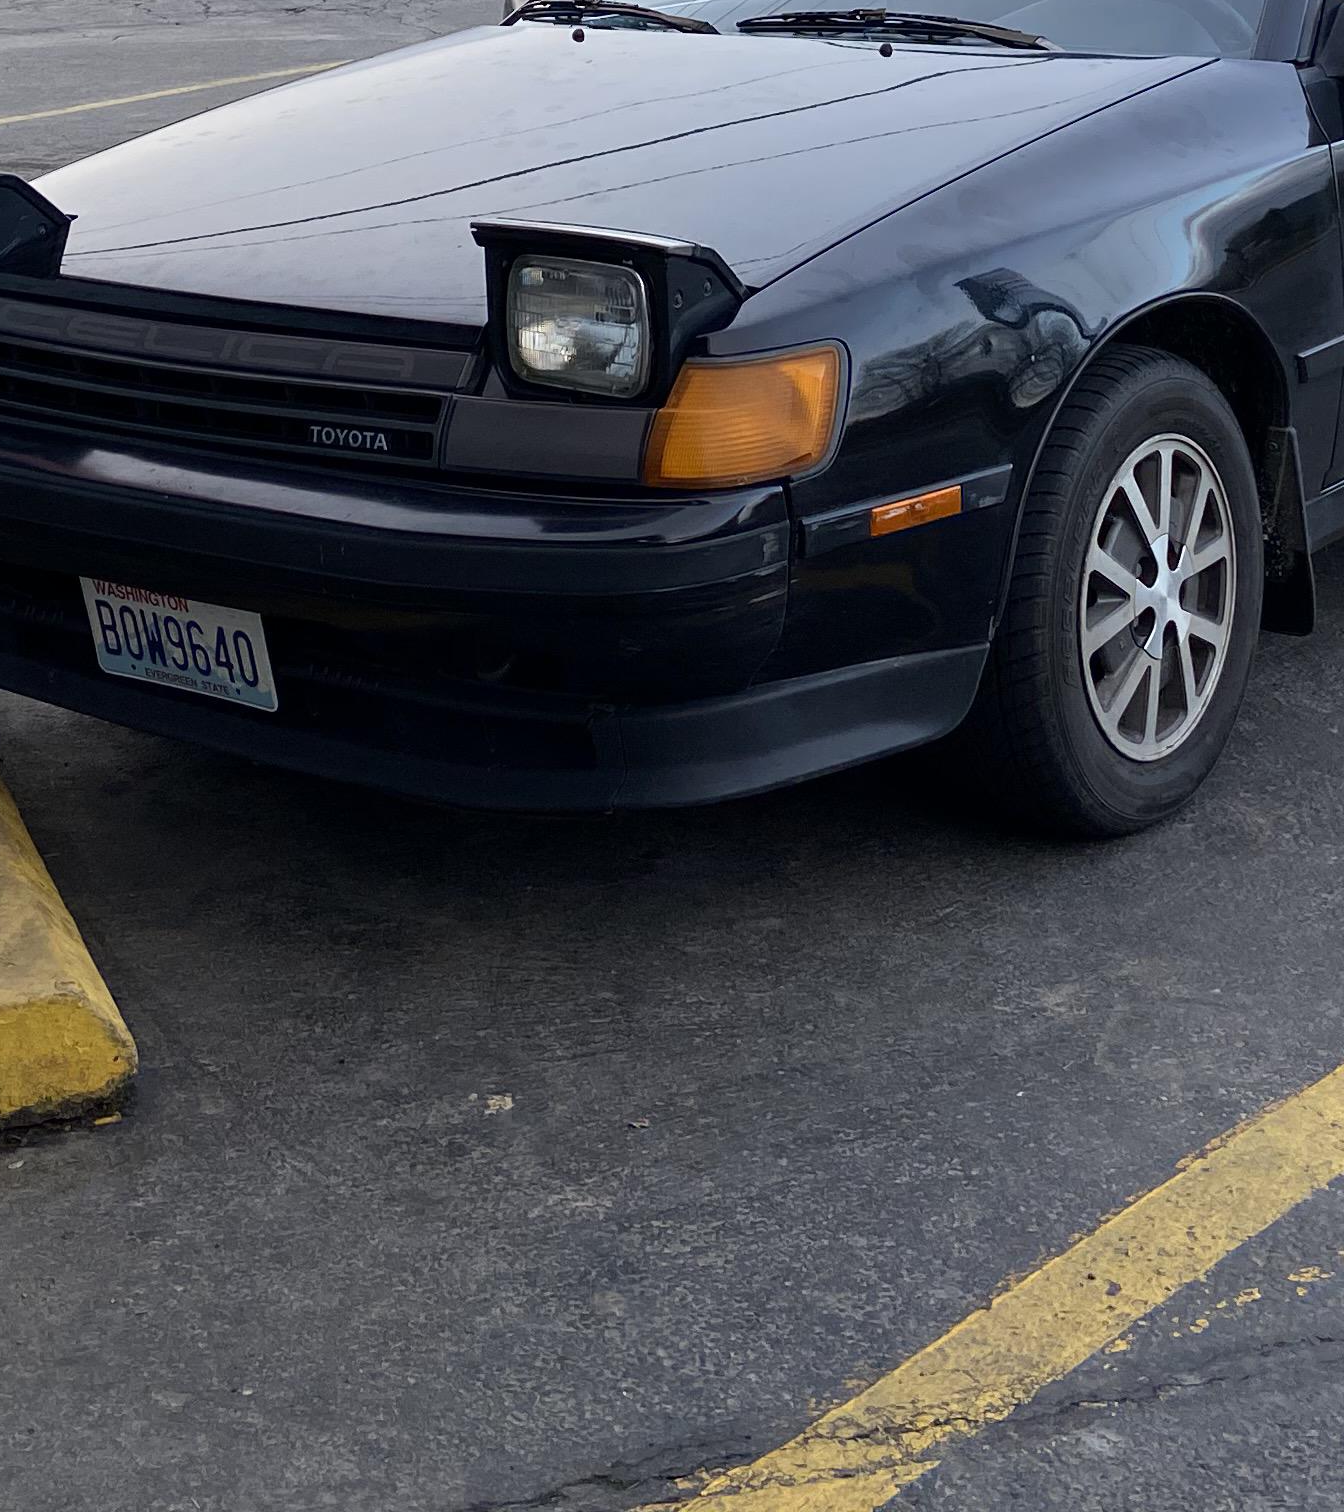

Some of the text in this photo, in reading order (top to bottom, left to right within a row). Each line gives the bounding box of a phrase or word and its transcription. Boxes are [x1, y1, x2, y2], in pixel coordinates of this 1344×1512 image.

[310, 425, 388, 451] TOYOTA
[93, 580, 190, 613] WASHINGTON
[95, 599, 259, 688] BOW9640
[144, 667, 230, 696] EVERGREEN STATE
